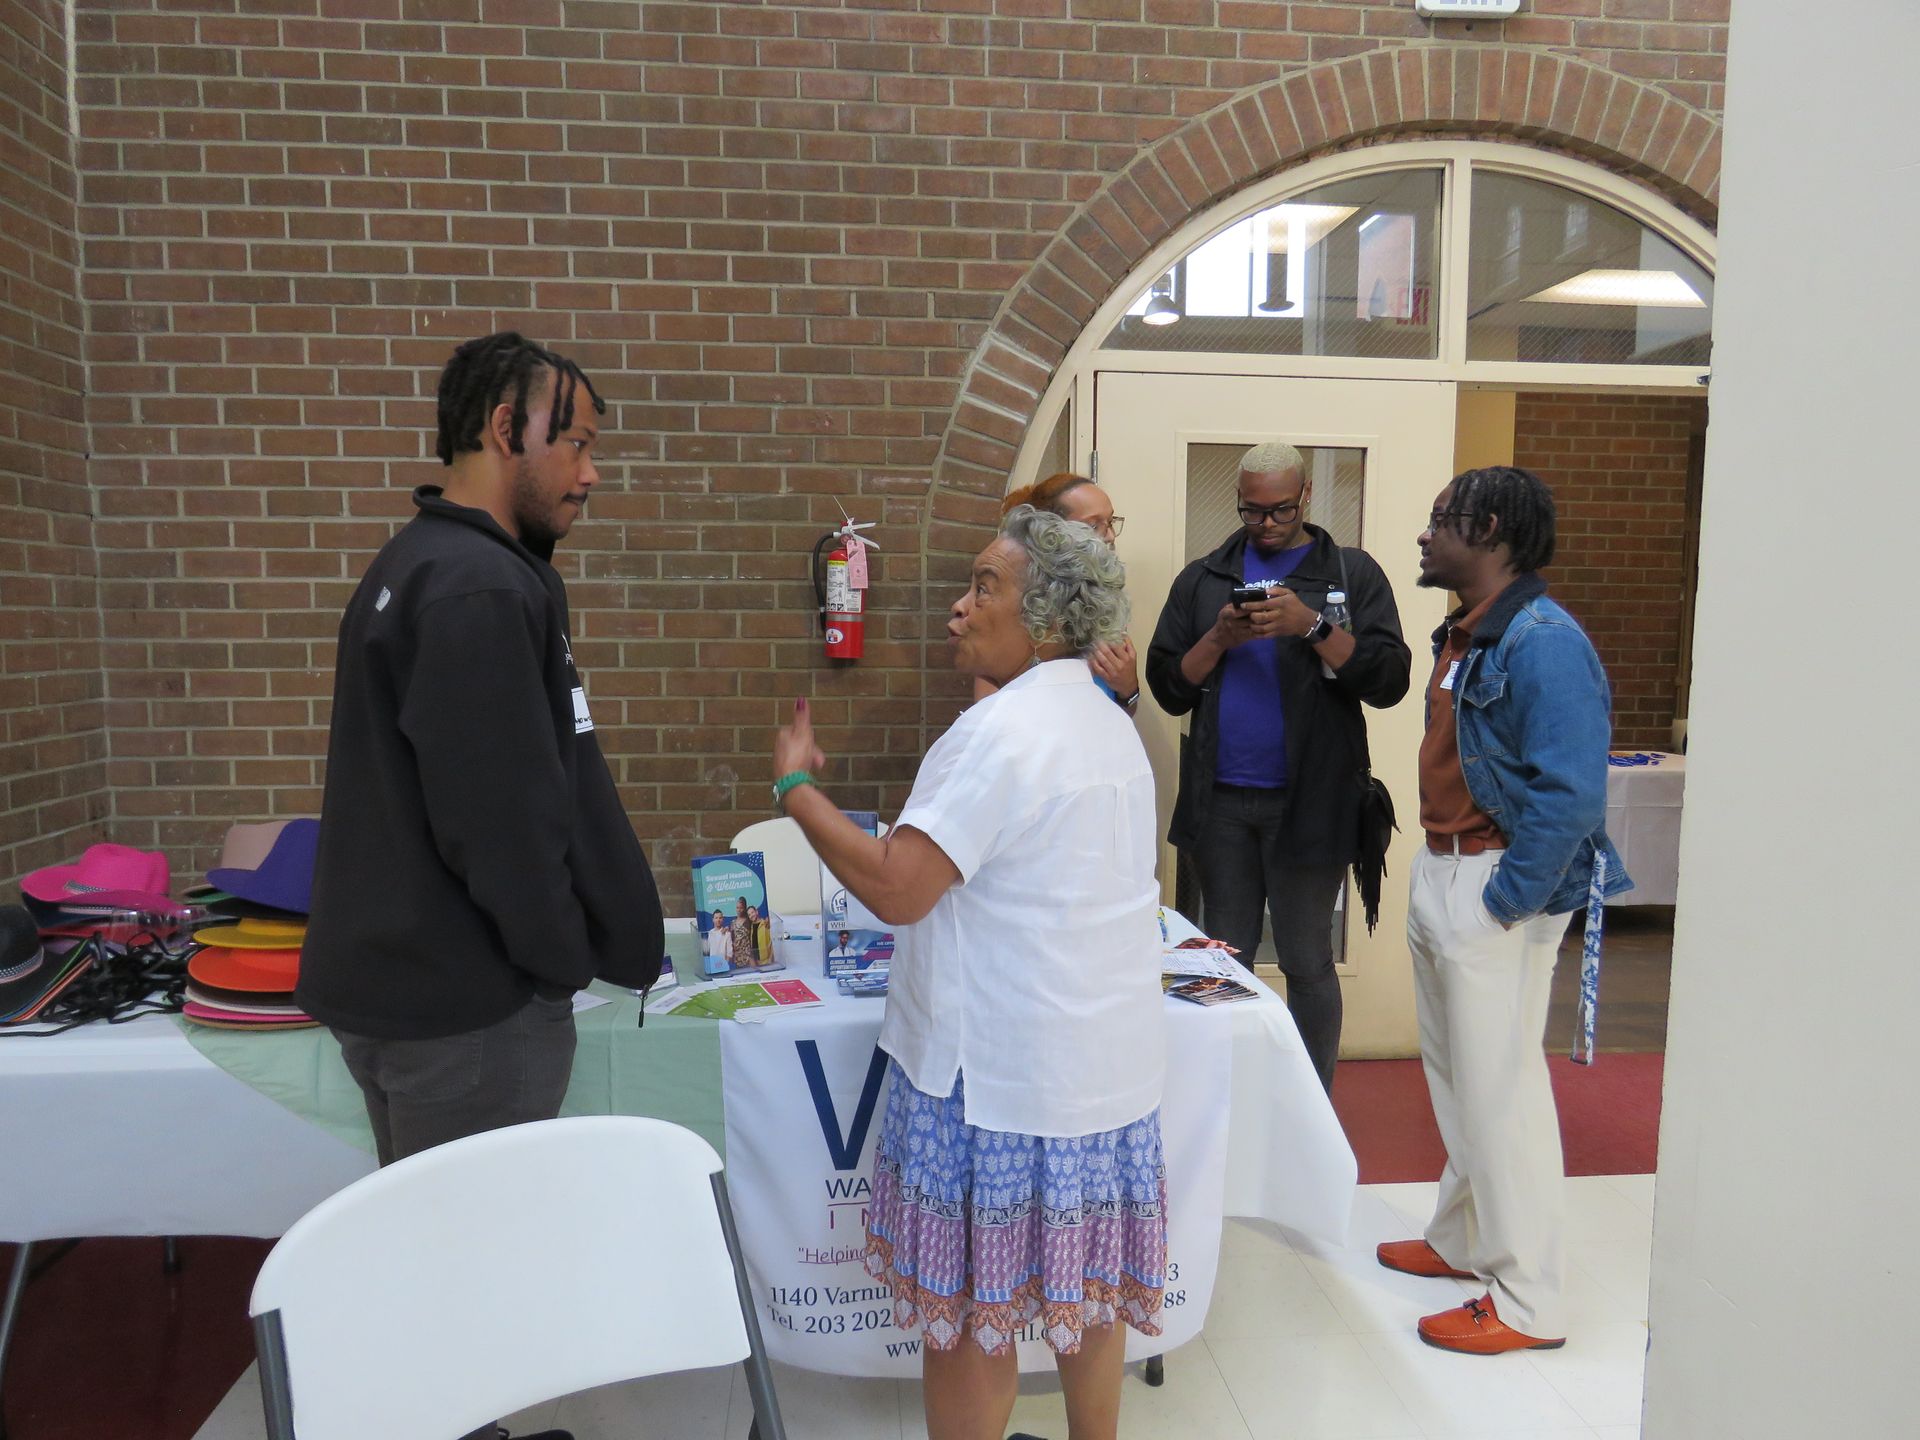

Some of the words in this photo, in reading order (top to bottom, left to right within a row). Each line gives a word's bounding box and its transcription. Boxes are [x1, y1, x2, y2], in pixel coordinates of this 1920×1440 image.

[825, 1177, 871, 1199] WA
[770, 1286, 818, 1307] 1140
[1168, 1262, 1179, 1281] 3
[767, 1304, 799, 1332] Tel.
[805, 1314, 845, 1334] 203
[852, 1308, 895, 1332] 202.
[1164, 1289, 1186, 1309] 88
[885, 1339, 922, 1358] ww
